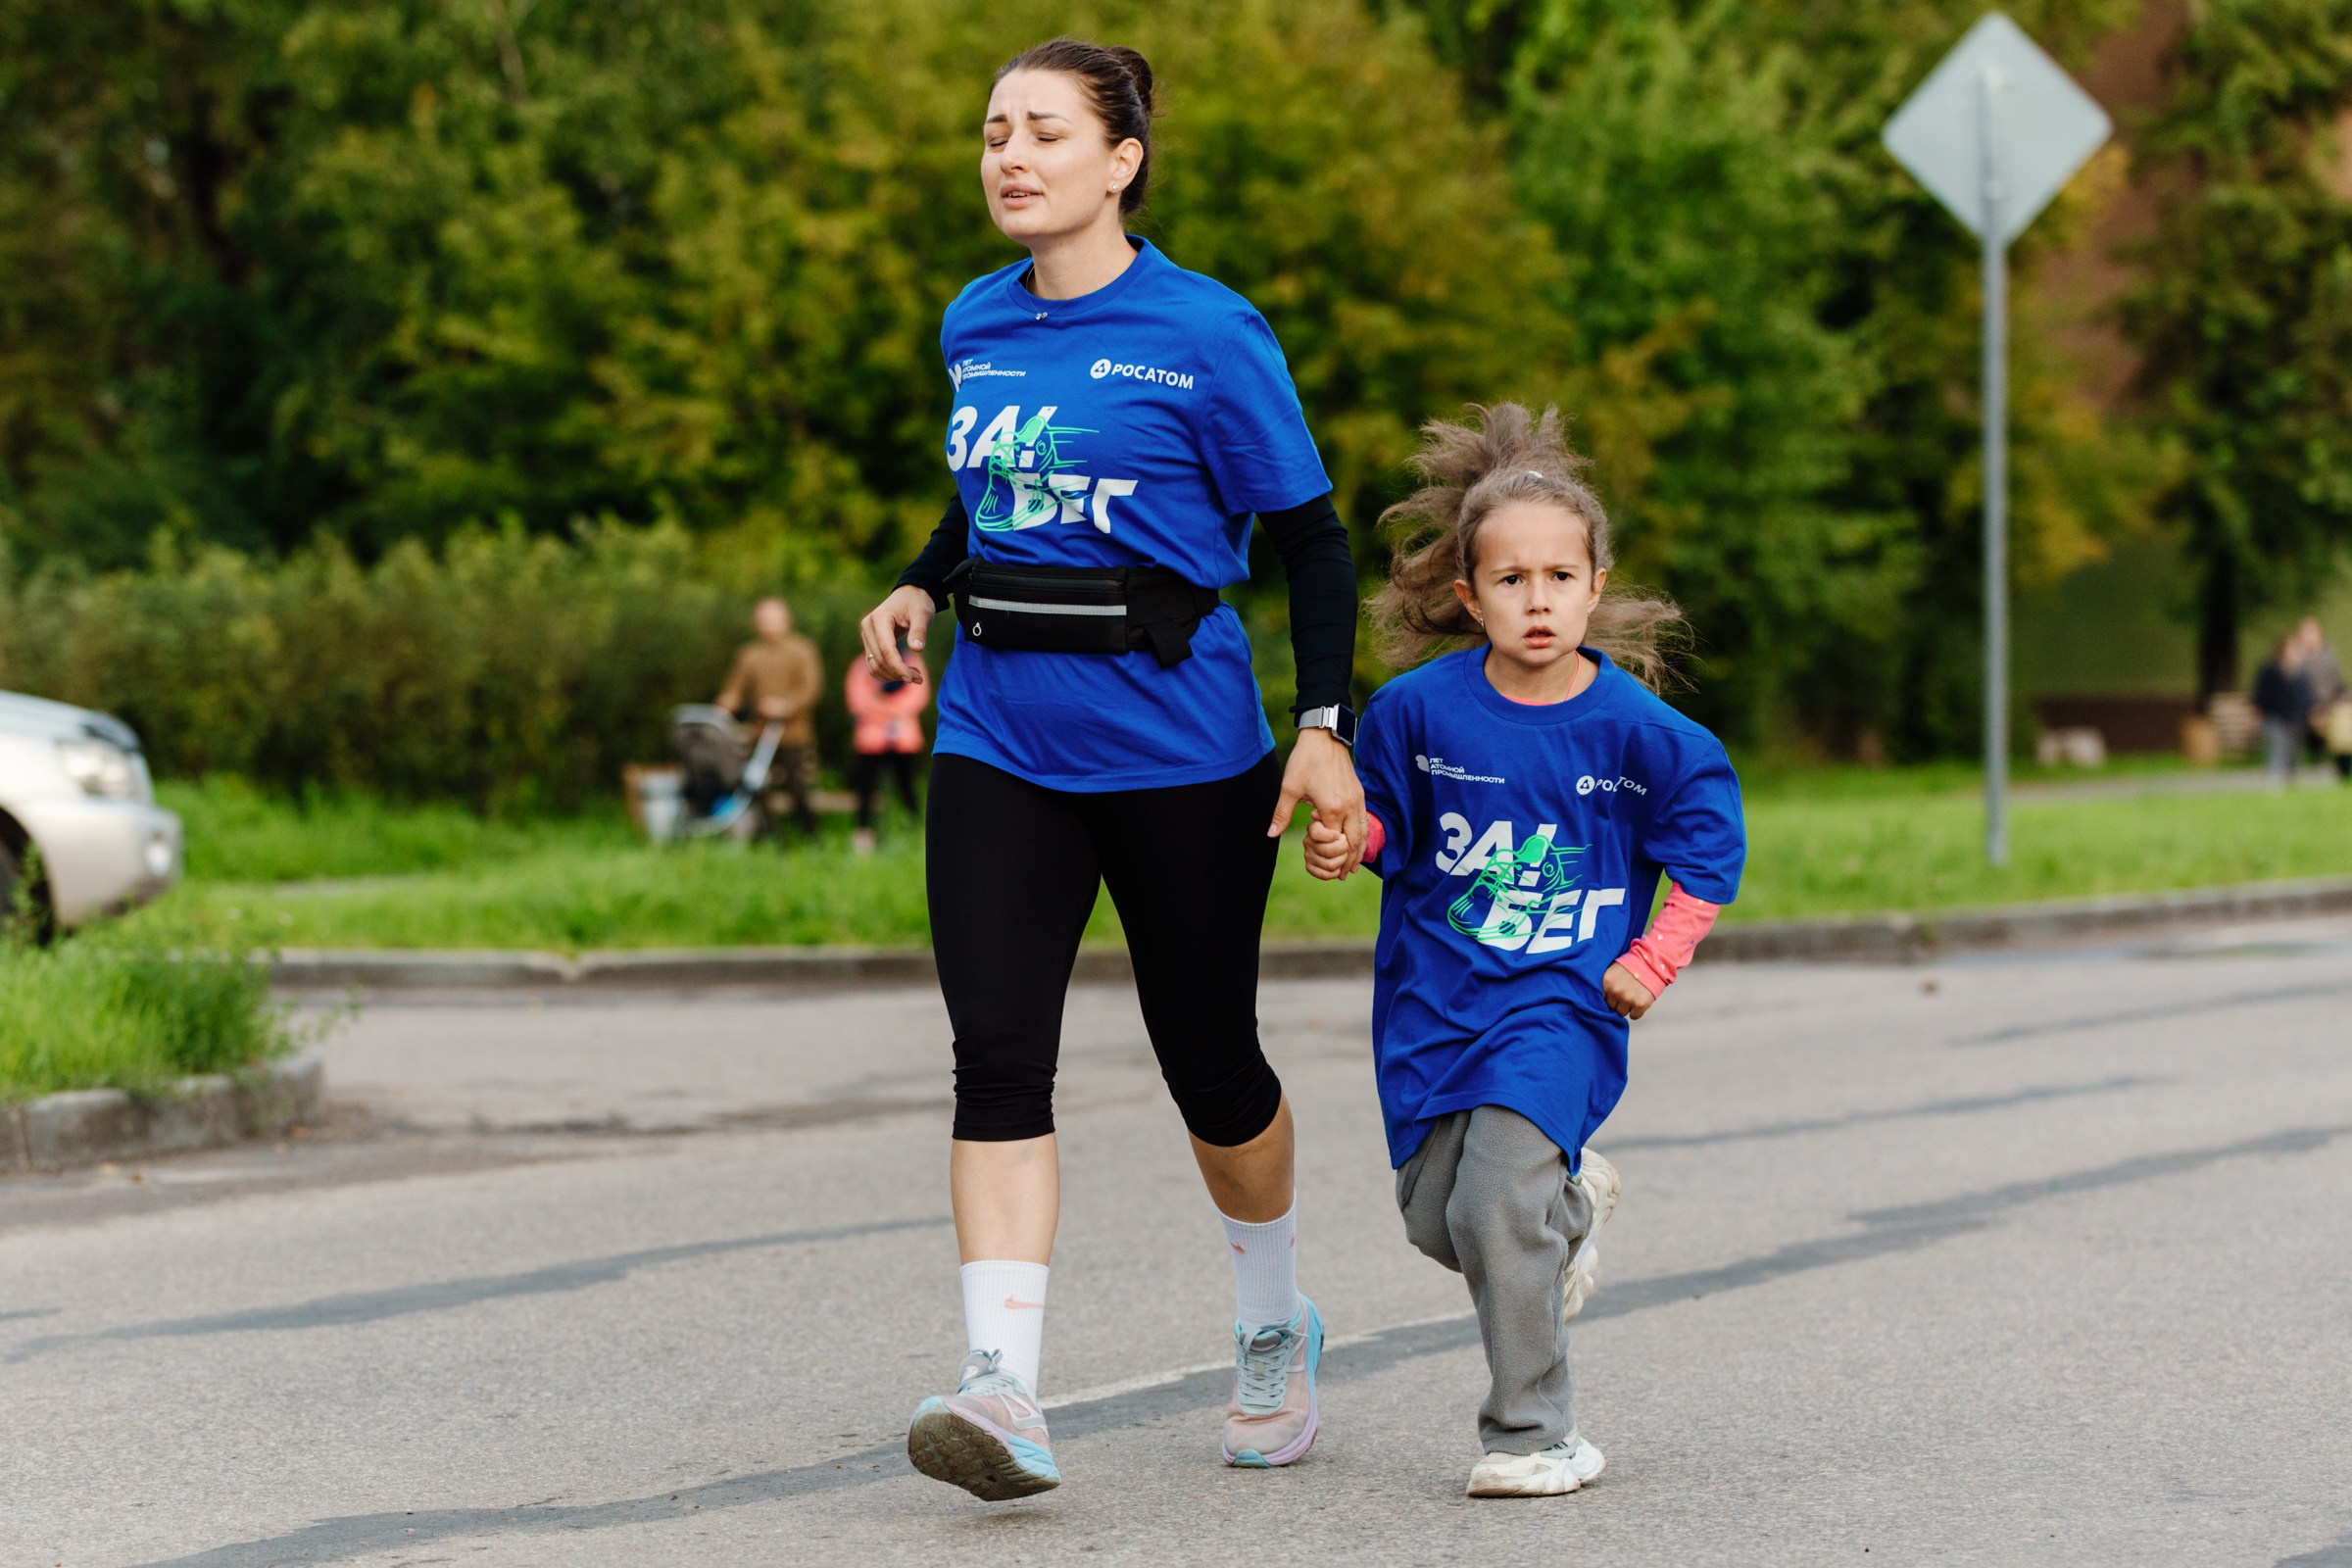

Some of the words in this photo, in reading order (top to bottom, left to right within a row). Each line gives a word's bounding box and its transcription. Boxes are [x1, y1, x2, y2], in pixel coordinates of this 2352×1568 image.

[1111, 364, 1194, 390] РОСАТОМ
[1008, 472, 1139, 534] БЕГ
[1431, 763, 1465, 774] АТОМНОЙ
[1431, 769, 1505, 784] ПРОМЫШЛЕННОСТИ
[1477, 888, 1626, 955] БЕГ
